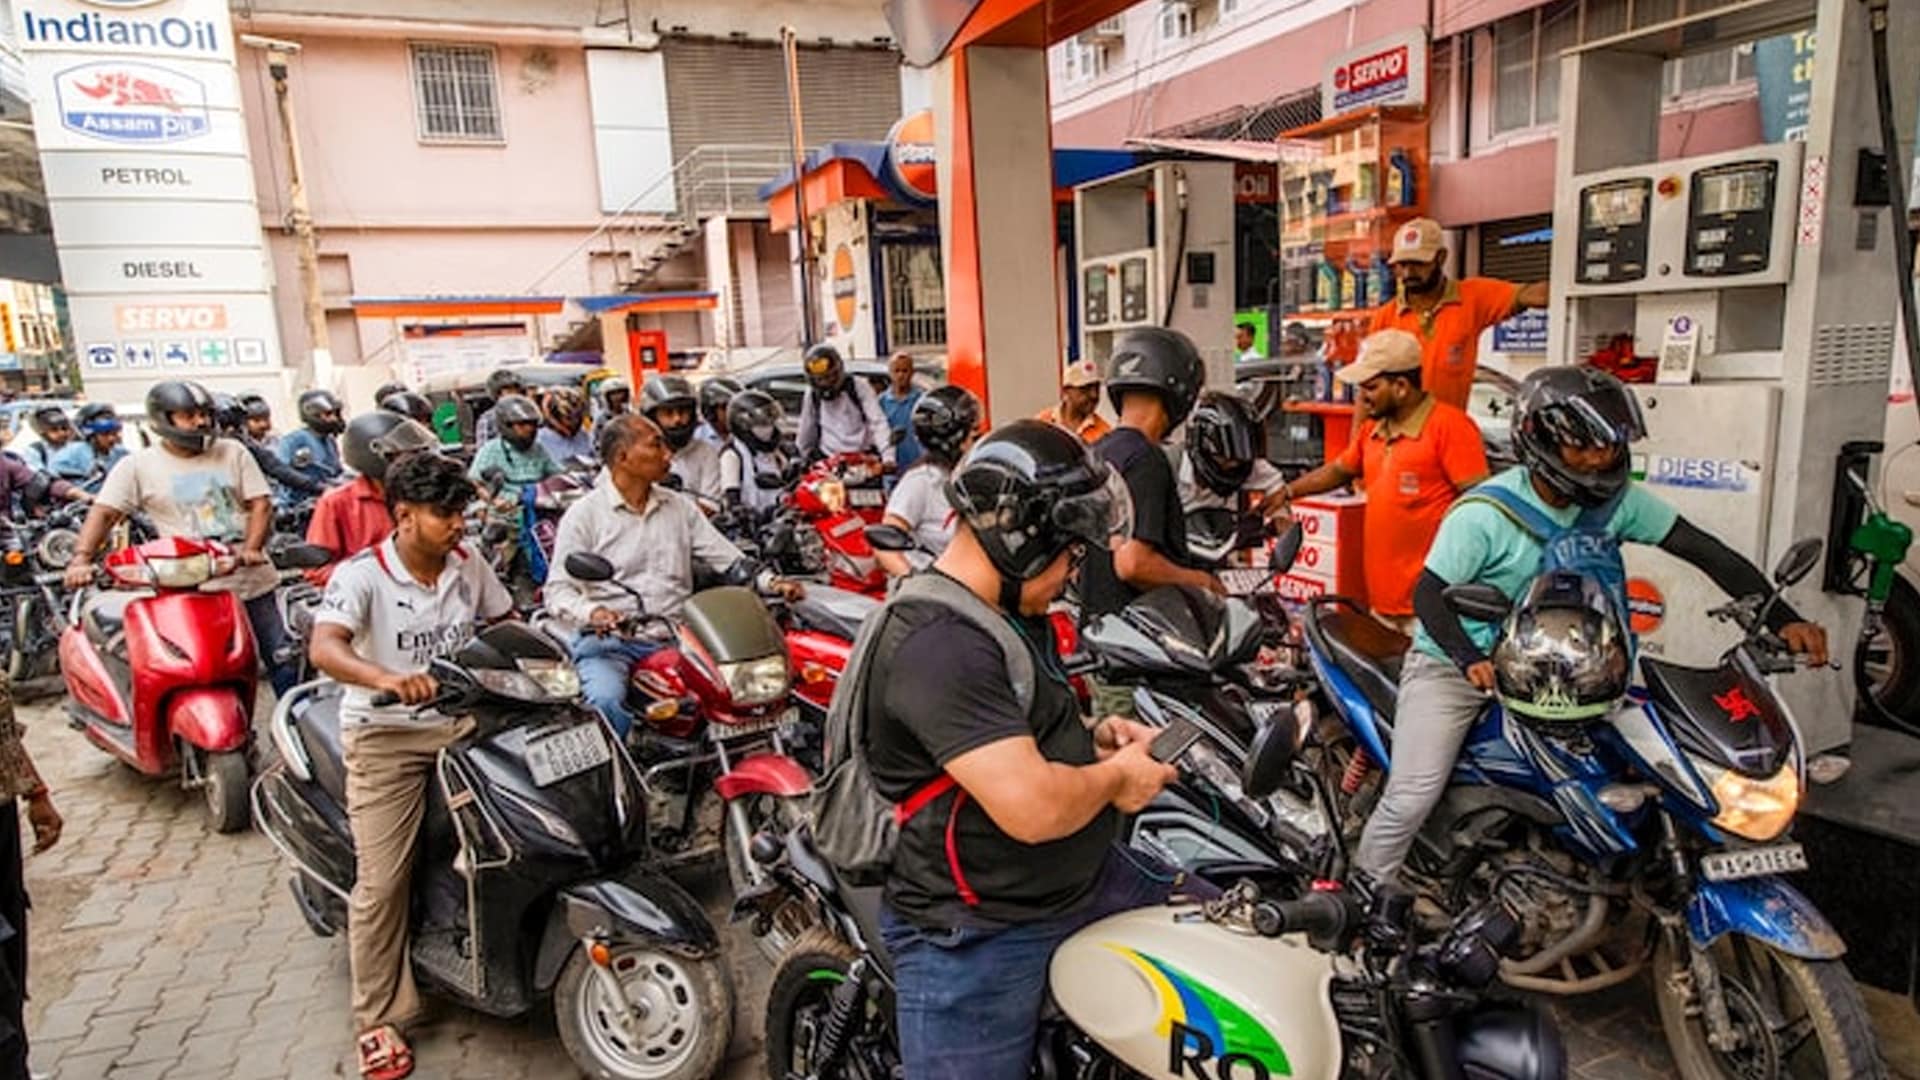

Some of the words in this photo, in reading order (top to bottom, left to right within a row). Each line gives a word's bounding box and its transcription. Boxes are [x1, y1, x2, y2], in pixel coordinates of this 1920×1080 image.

[24, 11, 218, 51] IndianOil
[1352, 53, 1402, 87] SERVO
[83, 117, 155, 132] Assam
[102, 168, 192, 185] PETROL
[123, 262, 202, 278] DIESEL
[122, 308, 215, 329] SERVO
[1658, 458, 1747, 483] DIESEL
